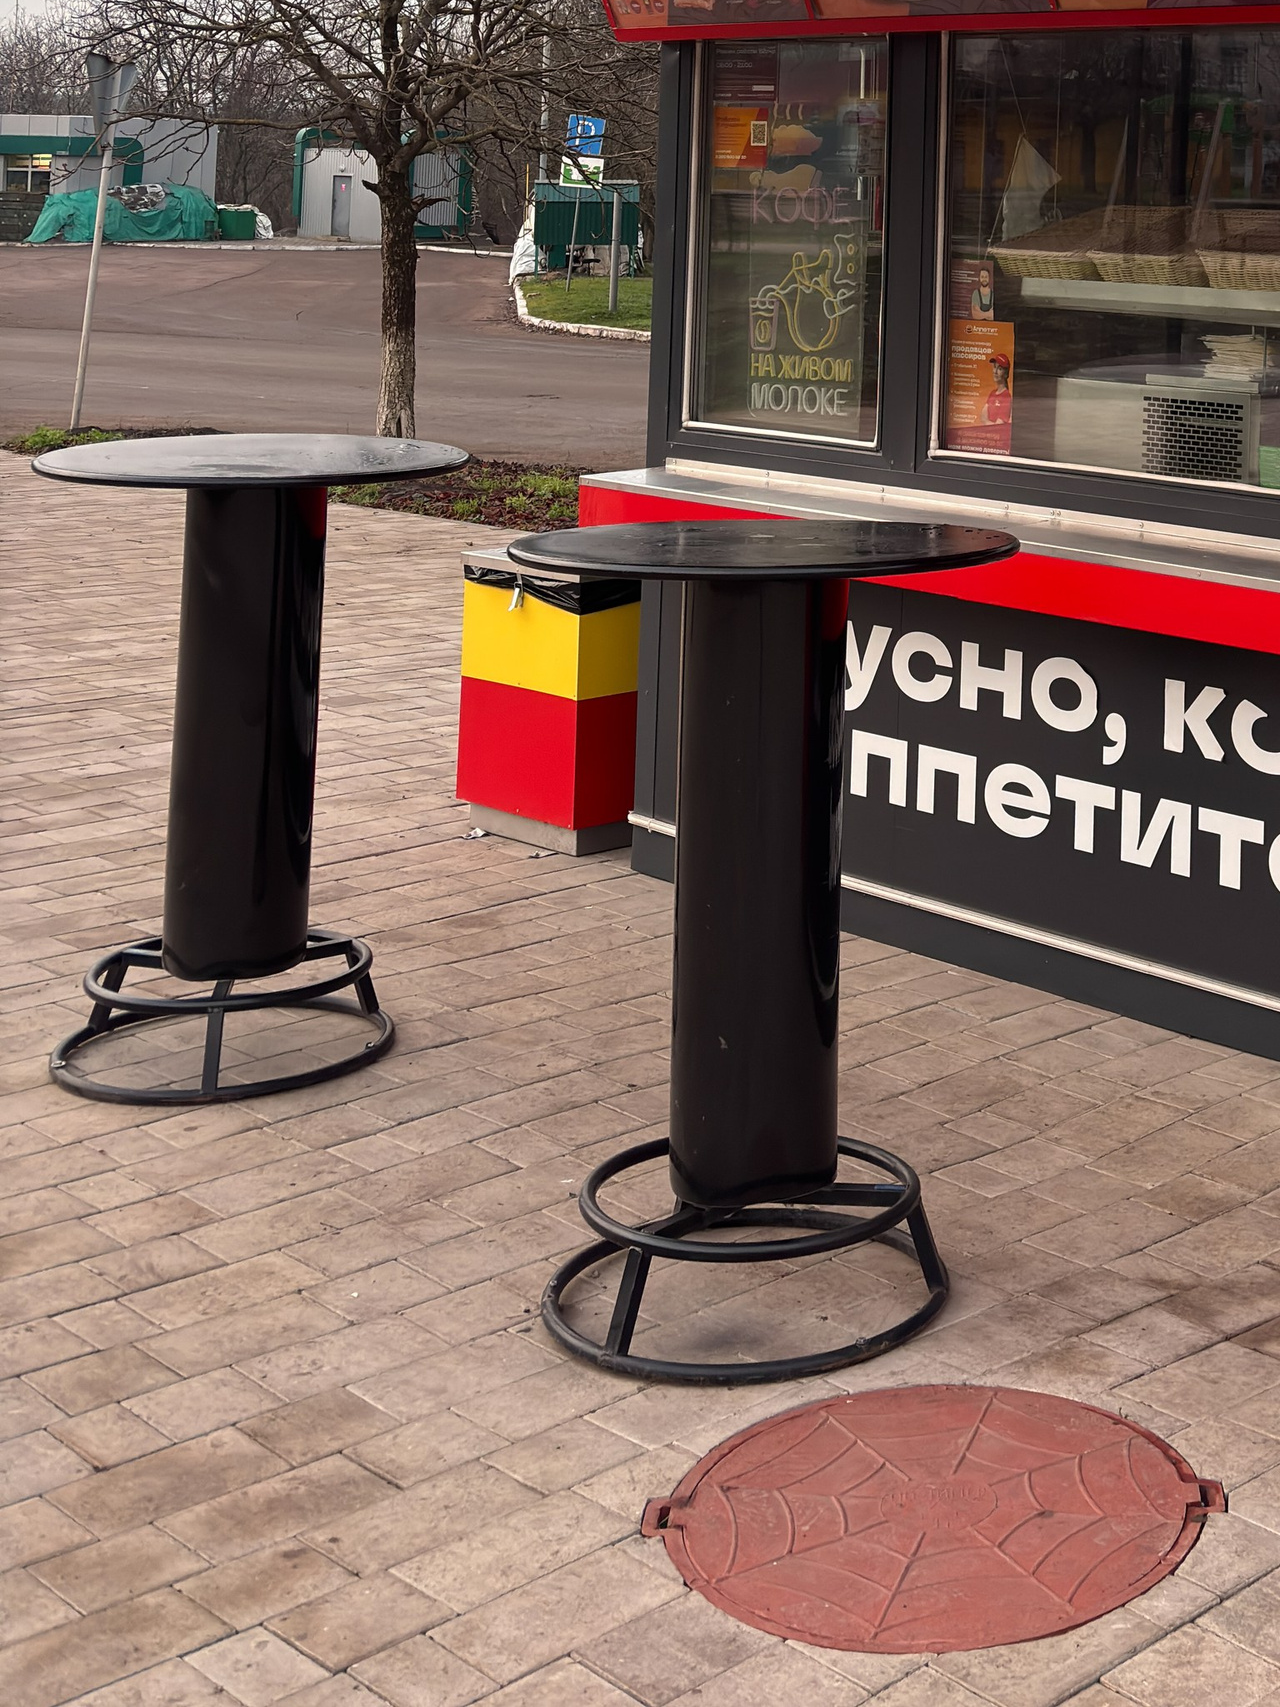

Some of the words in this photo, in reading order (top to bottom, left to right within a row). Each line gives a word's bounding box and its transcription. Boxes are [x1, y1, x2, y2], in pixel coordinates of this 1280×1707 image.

[752, 184, 852, 231] КОФЕ
[750, 353, 776, 379] НА
[778, 354, 854, 384] ЖИВОМ
[750, 383, 850, 417] МОЛОКЕ
